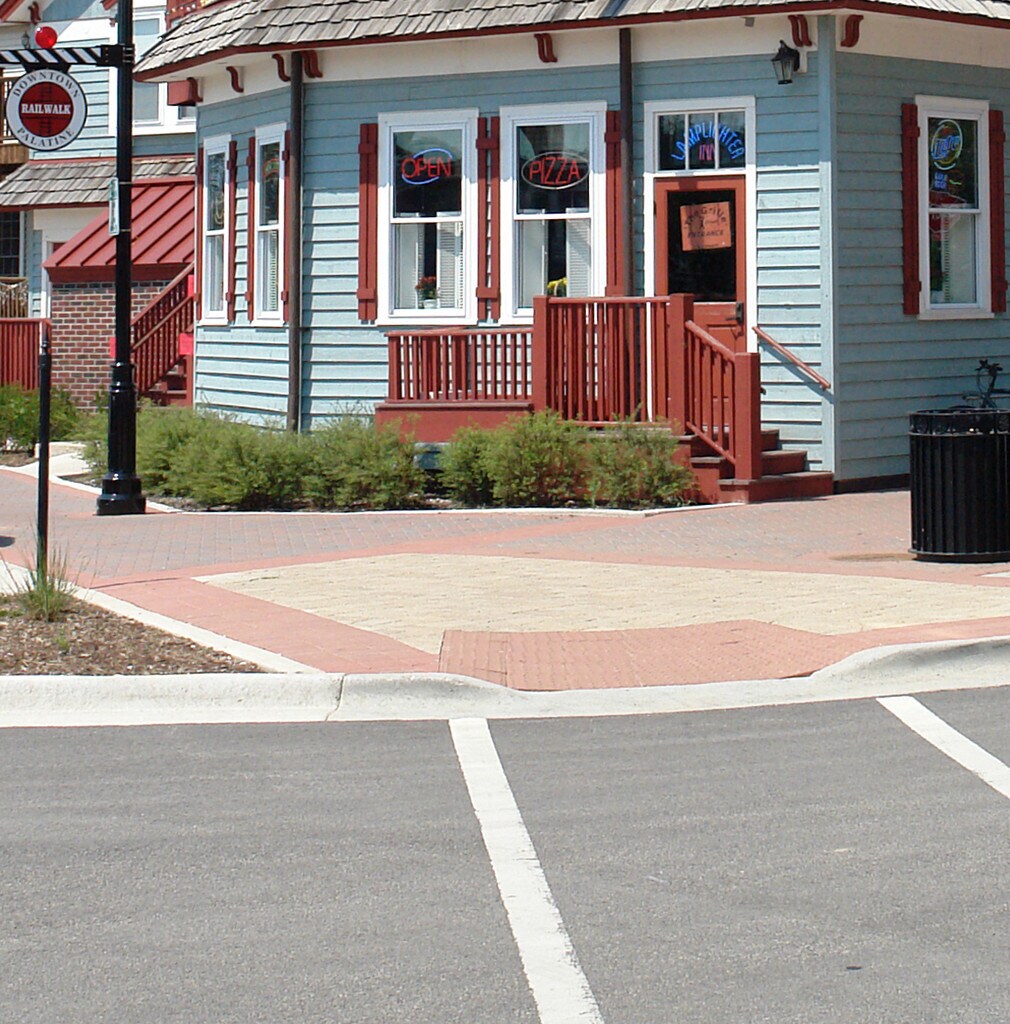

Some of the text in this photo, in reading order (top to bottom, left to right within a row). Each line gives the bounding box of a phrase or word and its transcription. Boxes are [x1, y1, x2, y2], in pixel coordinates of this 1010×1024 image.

[12, 70, 80, 98] DOWNTOWN
[21, 103, 71, 115] RAILWALK
[16, 128, 75, 147] PALATINE
[401, 156, 451, 179] OPEN
[528, 156, 581, 185] PIZZA
